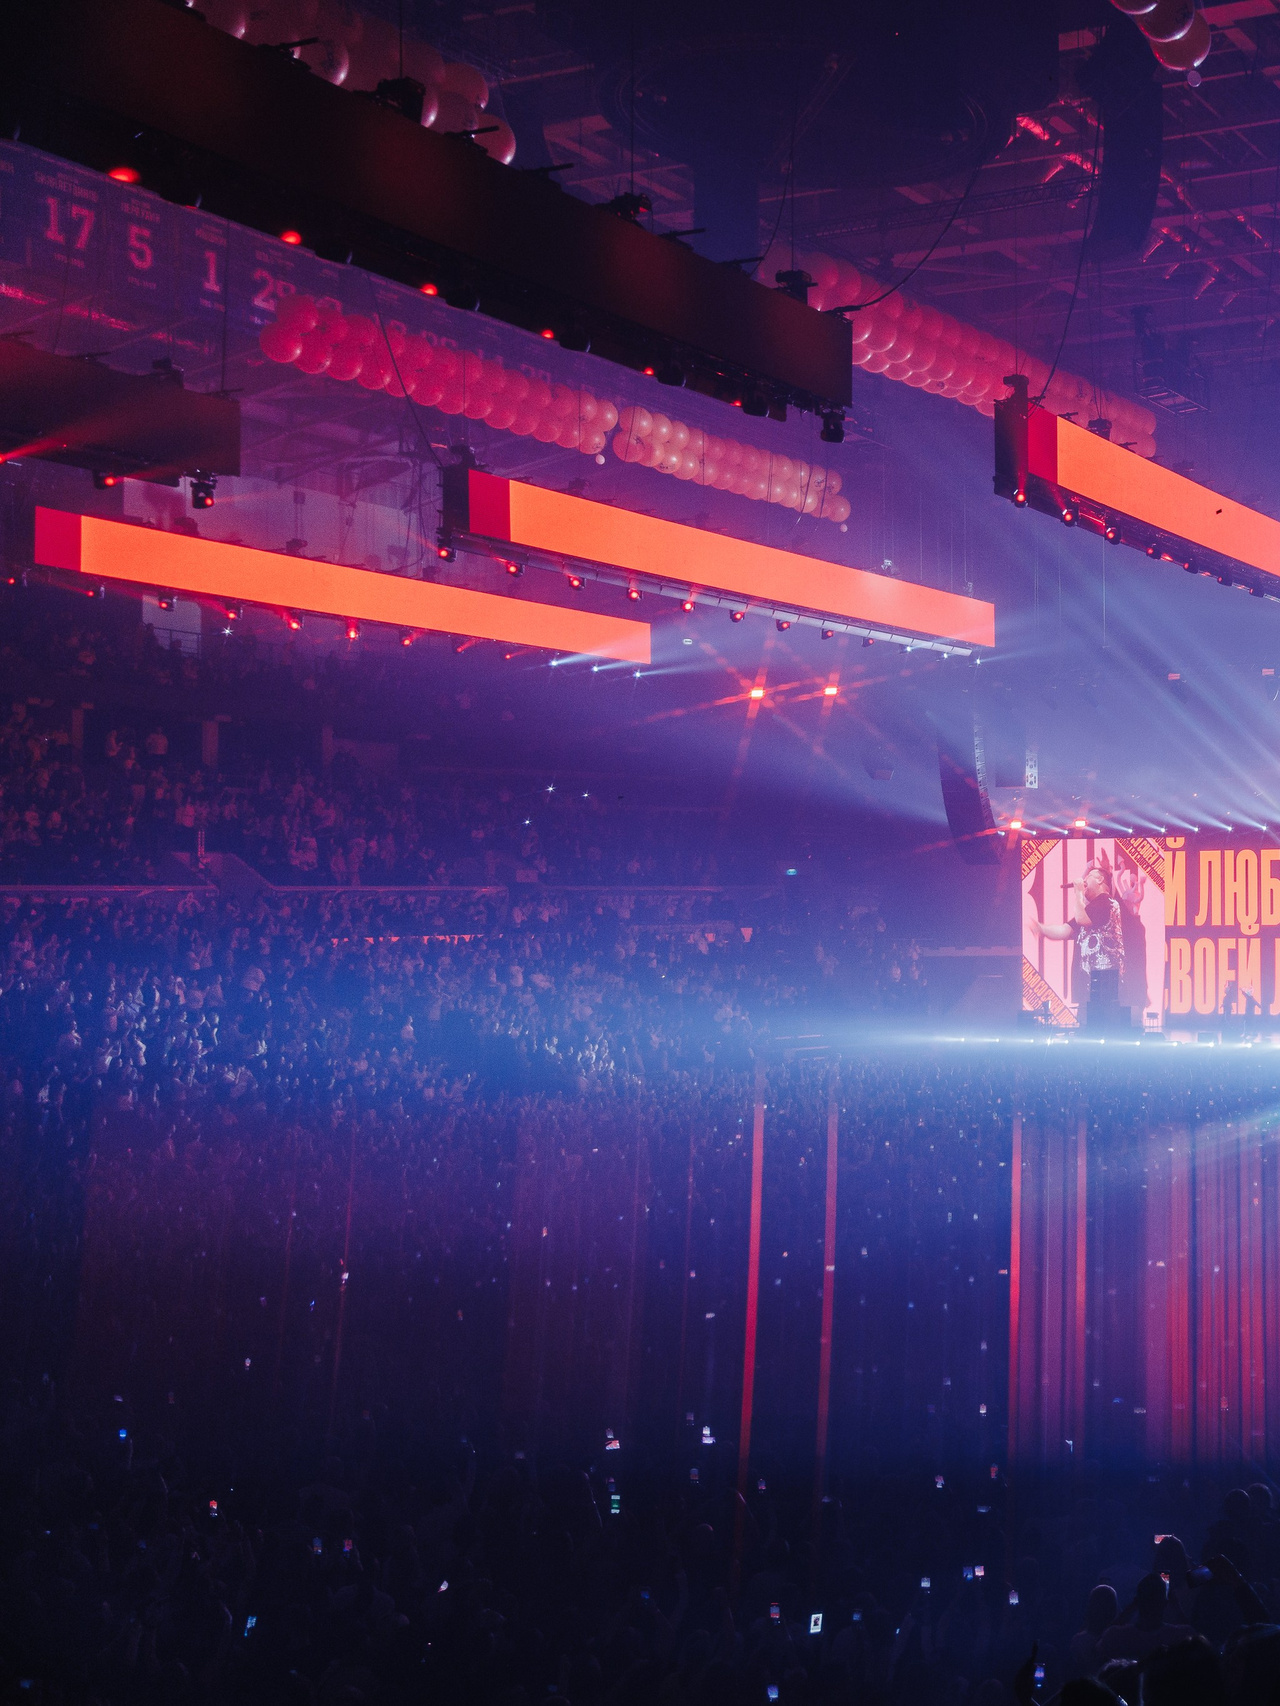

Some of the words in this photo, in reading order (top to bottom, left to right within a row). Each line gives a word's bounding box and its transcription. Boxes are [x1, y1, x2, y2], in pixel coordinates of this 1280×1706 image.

[44, 195, 95, 251] 17
[127, 224, 154, 271] 5
[202, 250, 221, 294] 1
